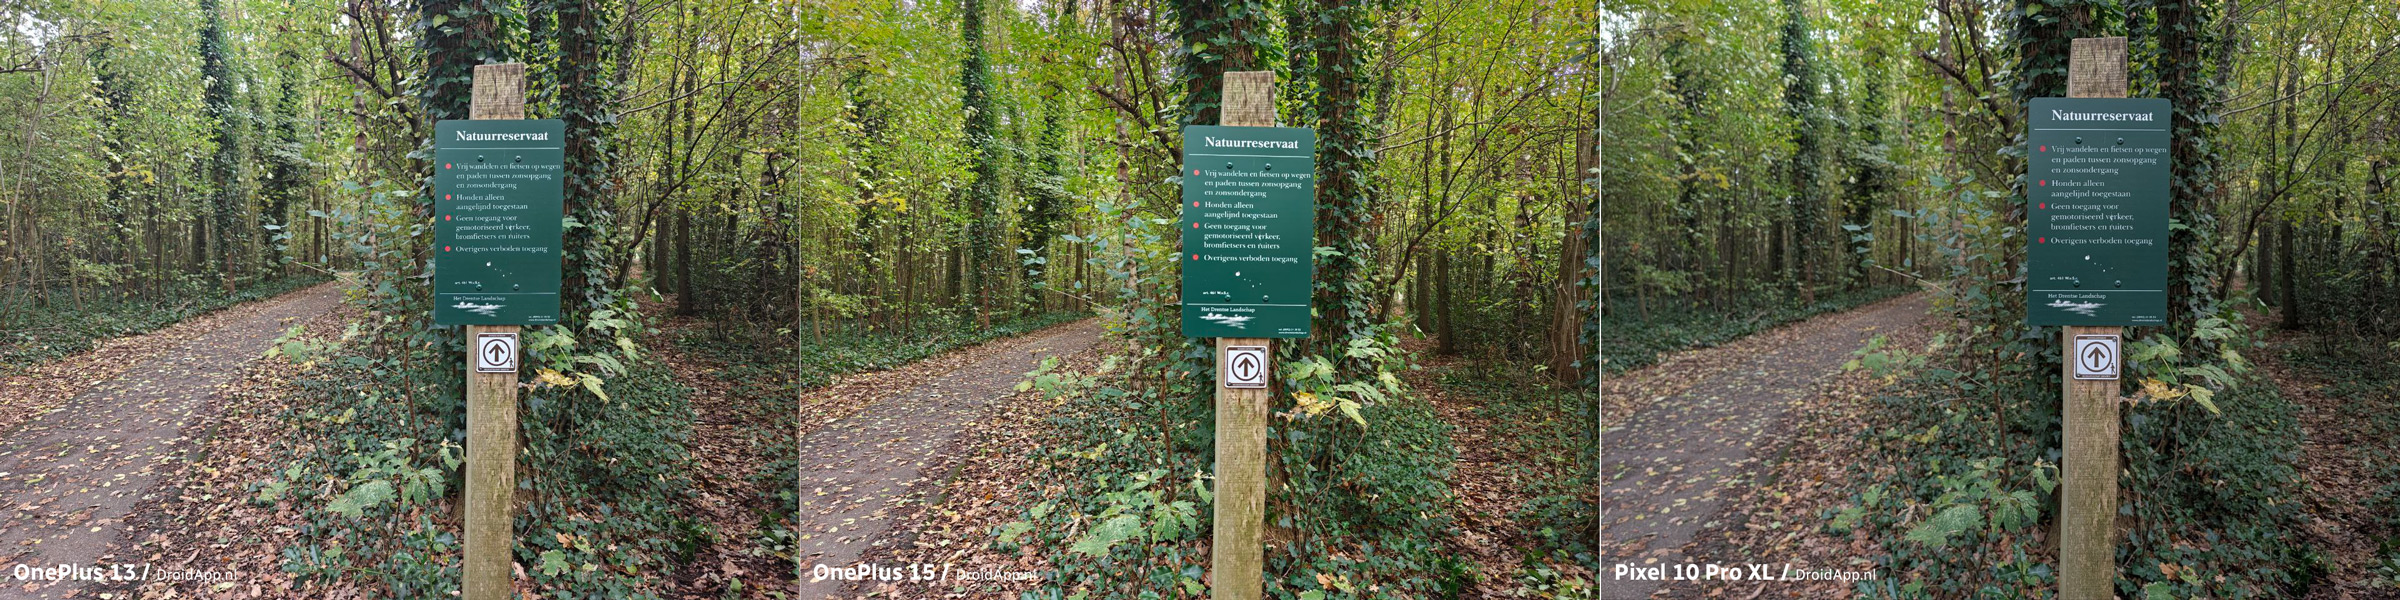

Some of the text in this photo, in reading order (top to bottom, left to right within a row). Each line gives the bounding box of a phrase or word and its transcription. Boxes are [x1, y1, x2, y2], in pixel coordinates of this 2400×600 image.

[2052, 110, 2153, 121] Natuurreservaat
[456, 131, 548, 141] Natuurreservaat
[1205, 136, 1298, 149] Natuurreservaat
[2052, 146, 2064, 154] Vrij
[2063, 156, 2086, 165] paden
[457, 163, 469, 171] Vrij
[2063, 166, 2119, 175] zonsondergang
[466, 172, 488, 181] paden
[1205, 170, 1217, 178] Vrij
[1215, 180, 1237, 188] paden
[2051, 190, 2090, 199] aangelijnd
[2051, 213, 2104, 222] gemotoriseerd
[2050, 237, 2087, 246] Overigens
